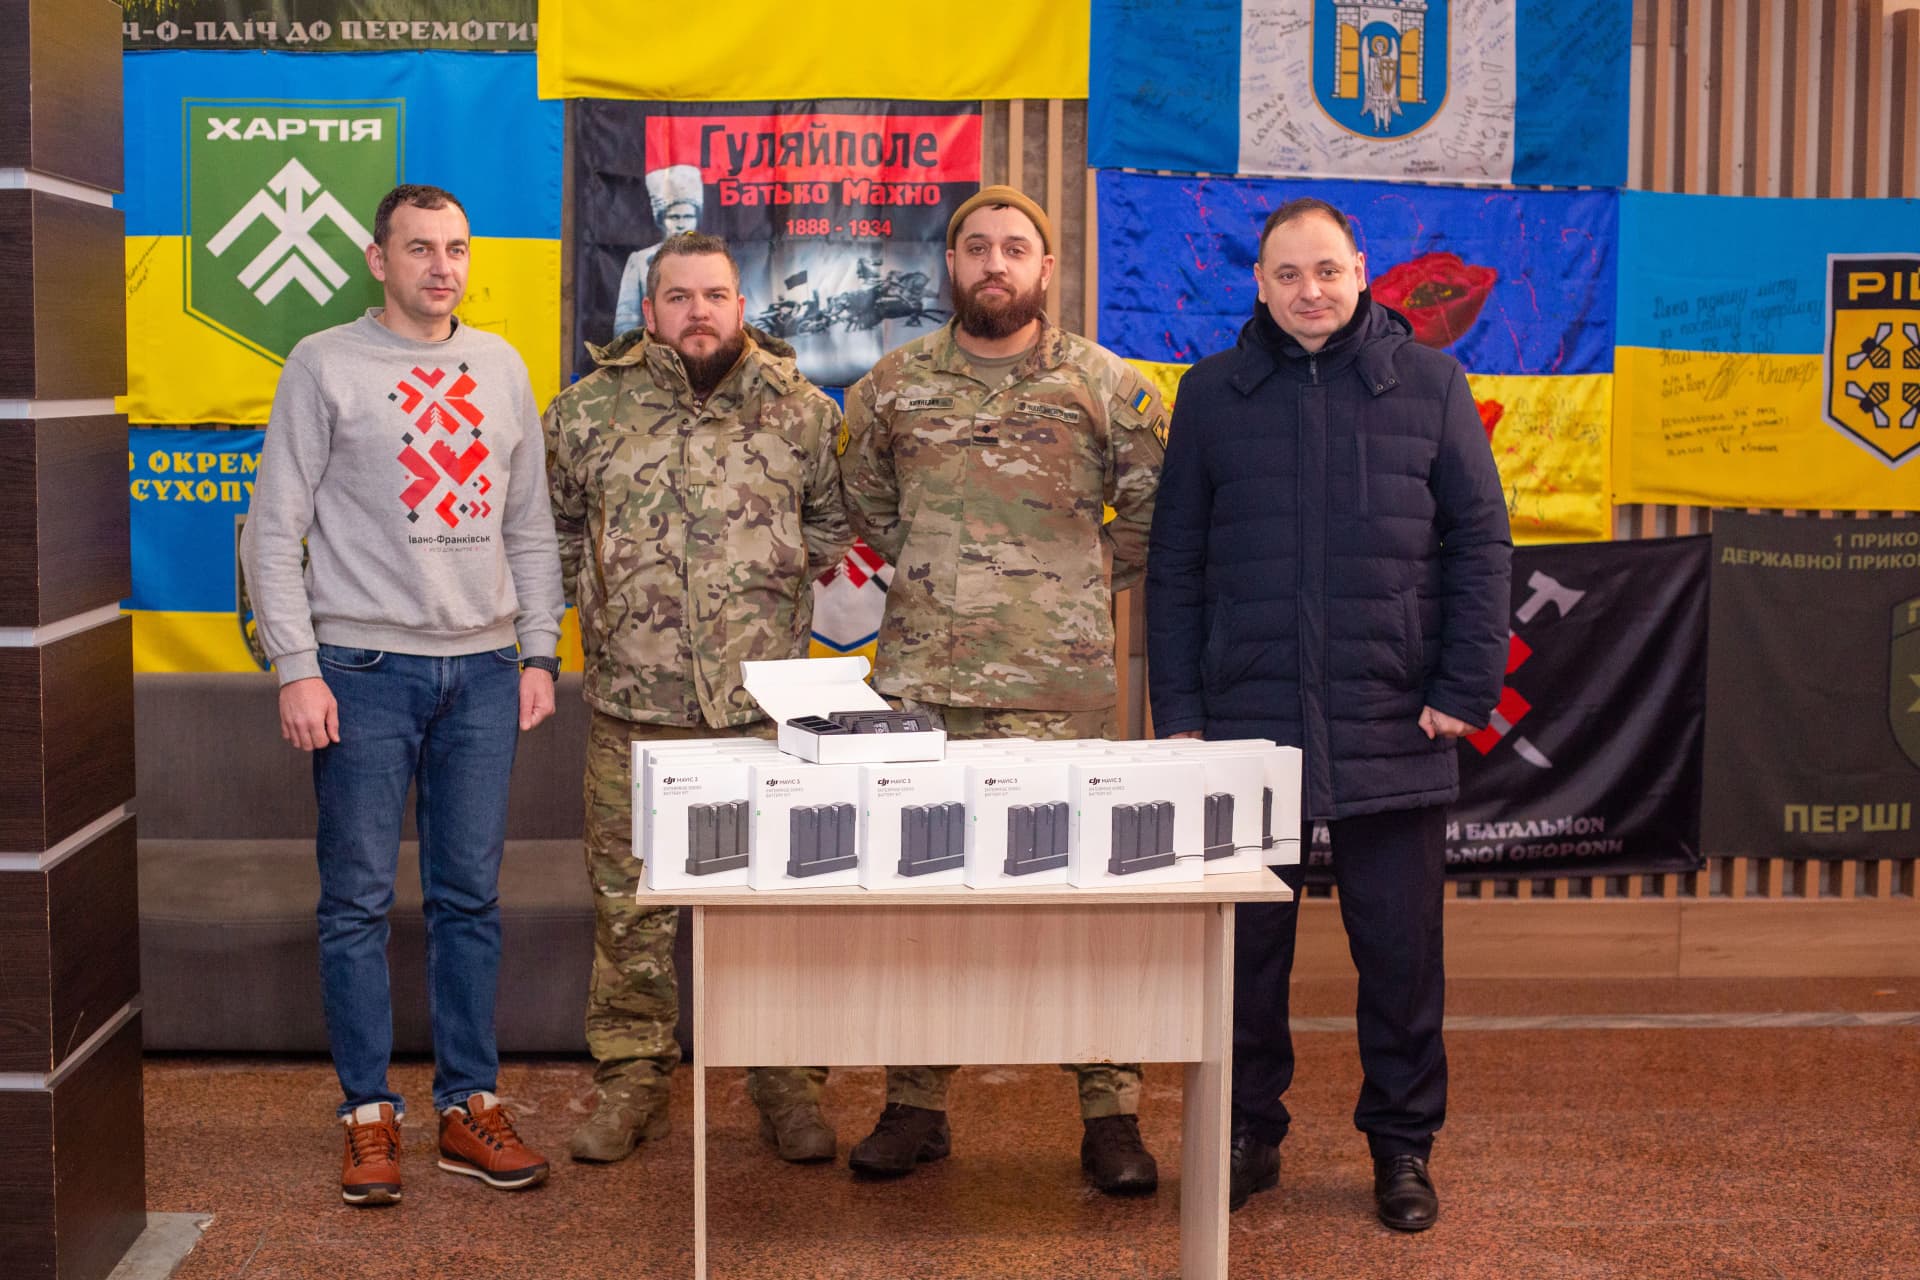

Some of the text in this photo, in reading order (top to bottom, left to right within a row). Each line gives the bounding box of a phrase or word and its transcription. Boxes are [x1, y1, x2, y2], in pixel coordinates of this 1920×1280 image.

[285, 20, 332, 44] ДО
[206, 117, 383, 142] ХАРТІЯ
[701, 122, 938, 177] Гуляйполе
[719, 177, 942, 207] Батько Махно
[786, 218, 830, 237] 1888
[848, 219, 892, 237] 1934
[1721, 547, 1920, 570] ДЕРЖАВНОЇ ПРИКО
[1784, 803, 1911, 833] ПЕРШІ
